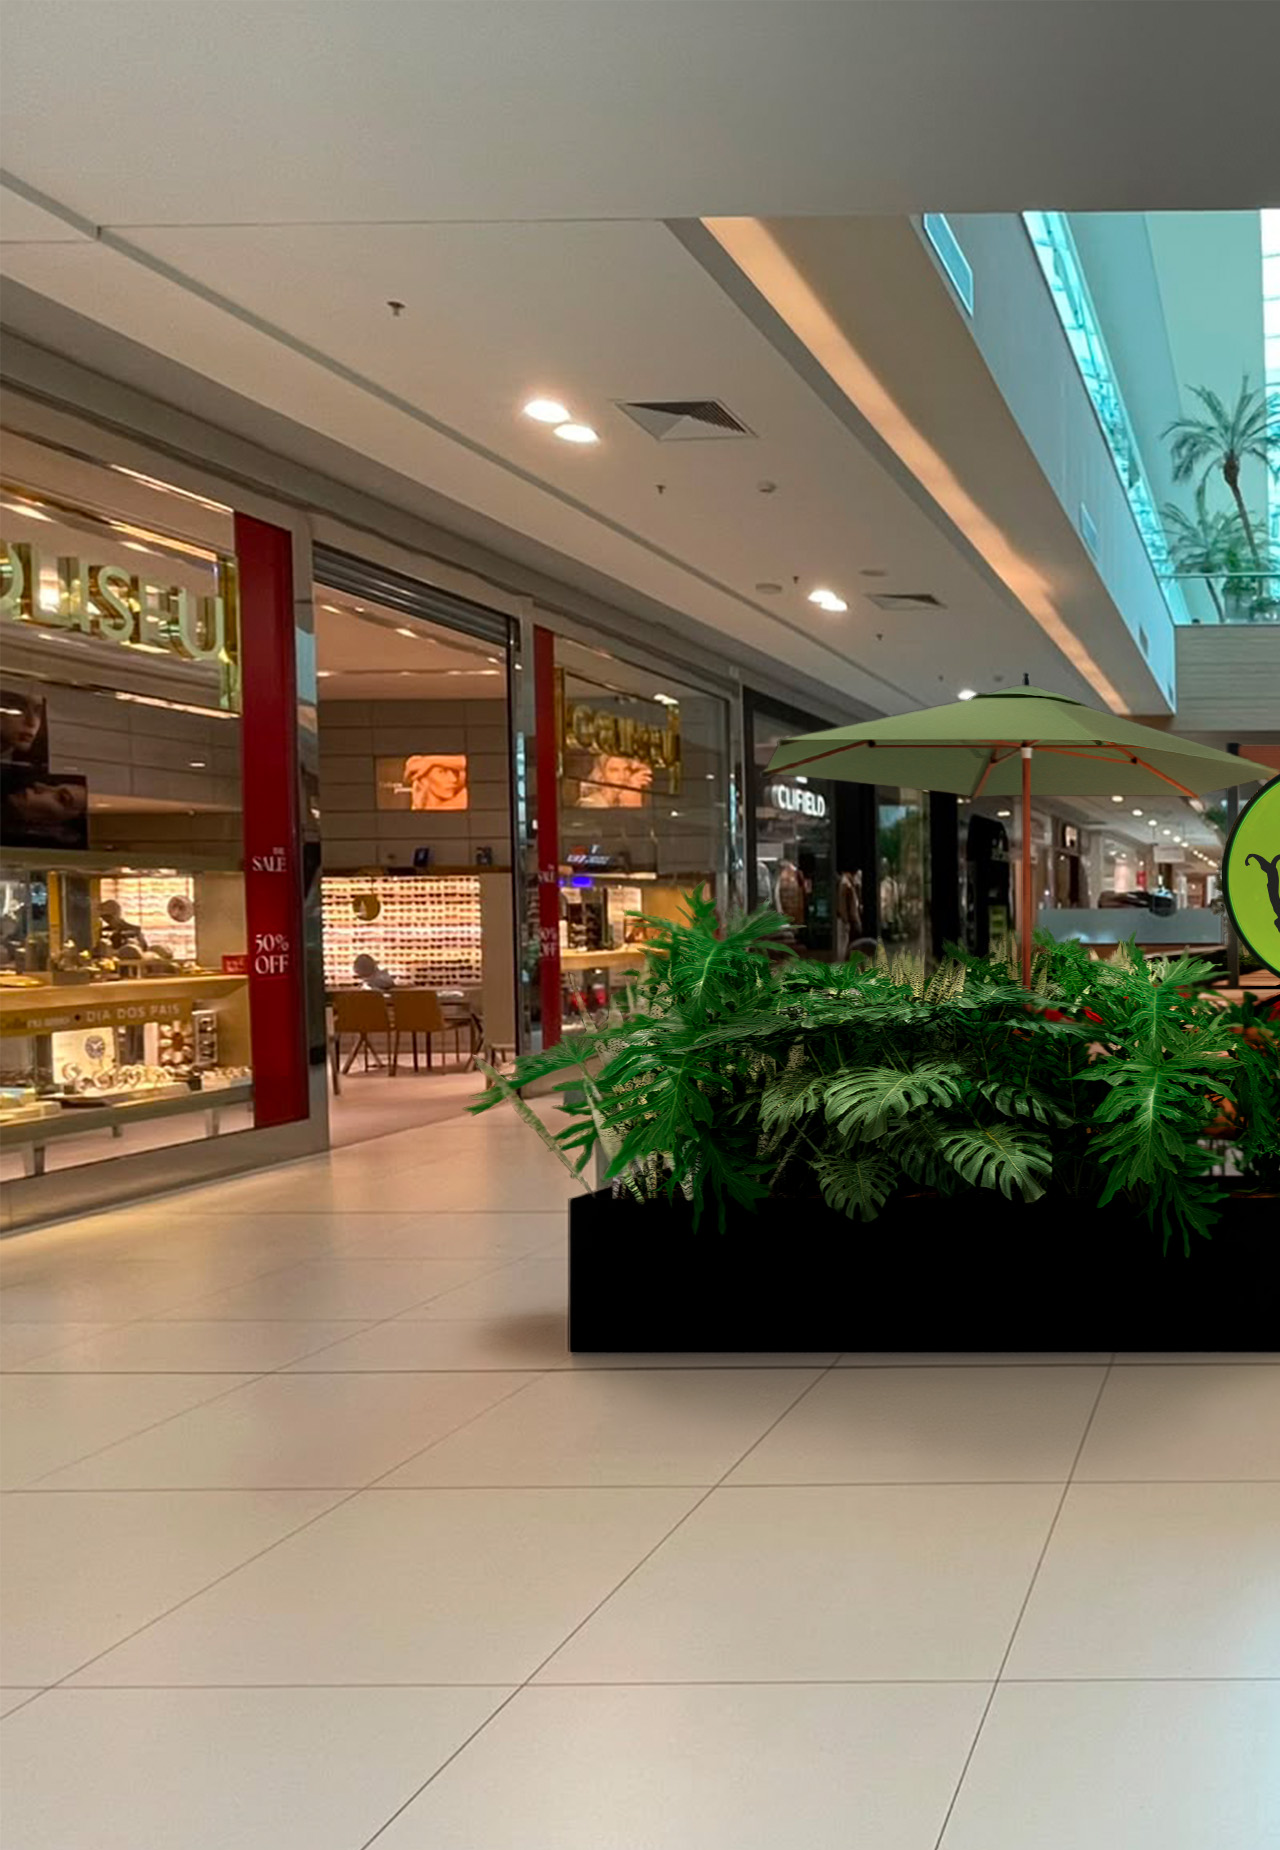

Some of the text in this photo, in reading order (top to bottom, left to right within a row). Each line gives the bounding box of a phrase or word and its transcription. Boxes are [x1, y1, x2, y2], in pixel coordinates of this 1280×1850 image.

[252, 856, 288, 872] SALE
[255, 933, 290, 954] 50%
[254, 954, 289, 974] OFF
[86, 1010, 111, 1023] DIA
[117, 1006, 146, 1020] DOS
[151, 1003, 181, 1017] PAIS
